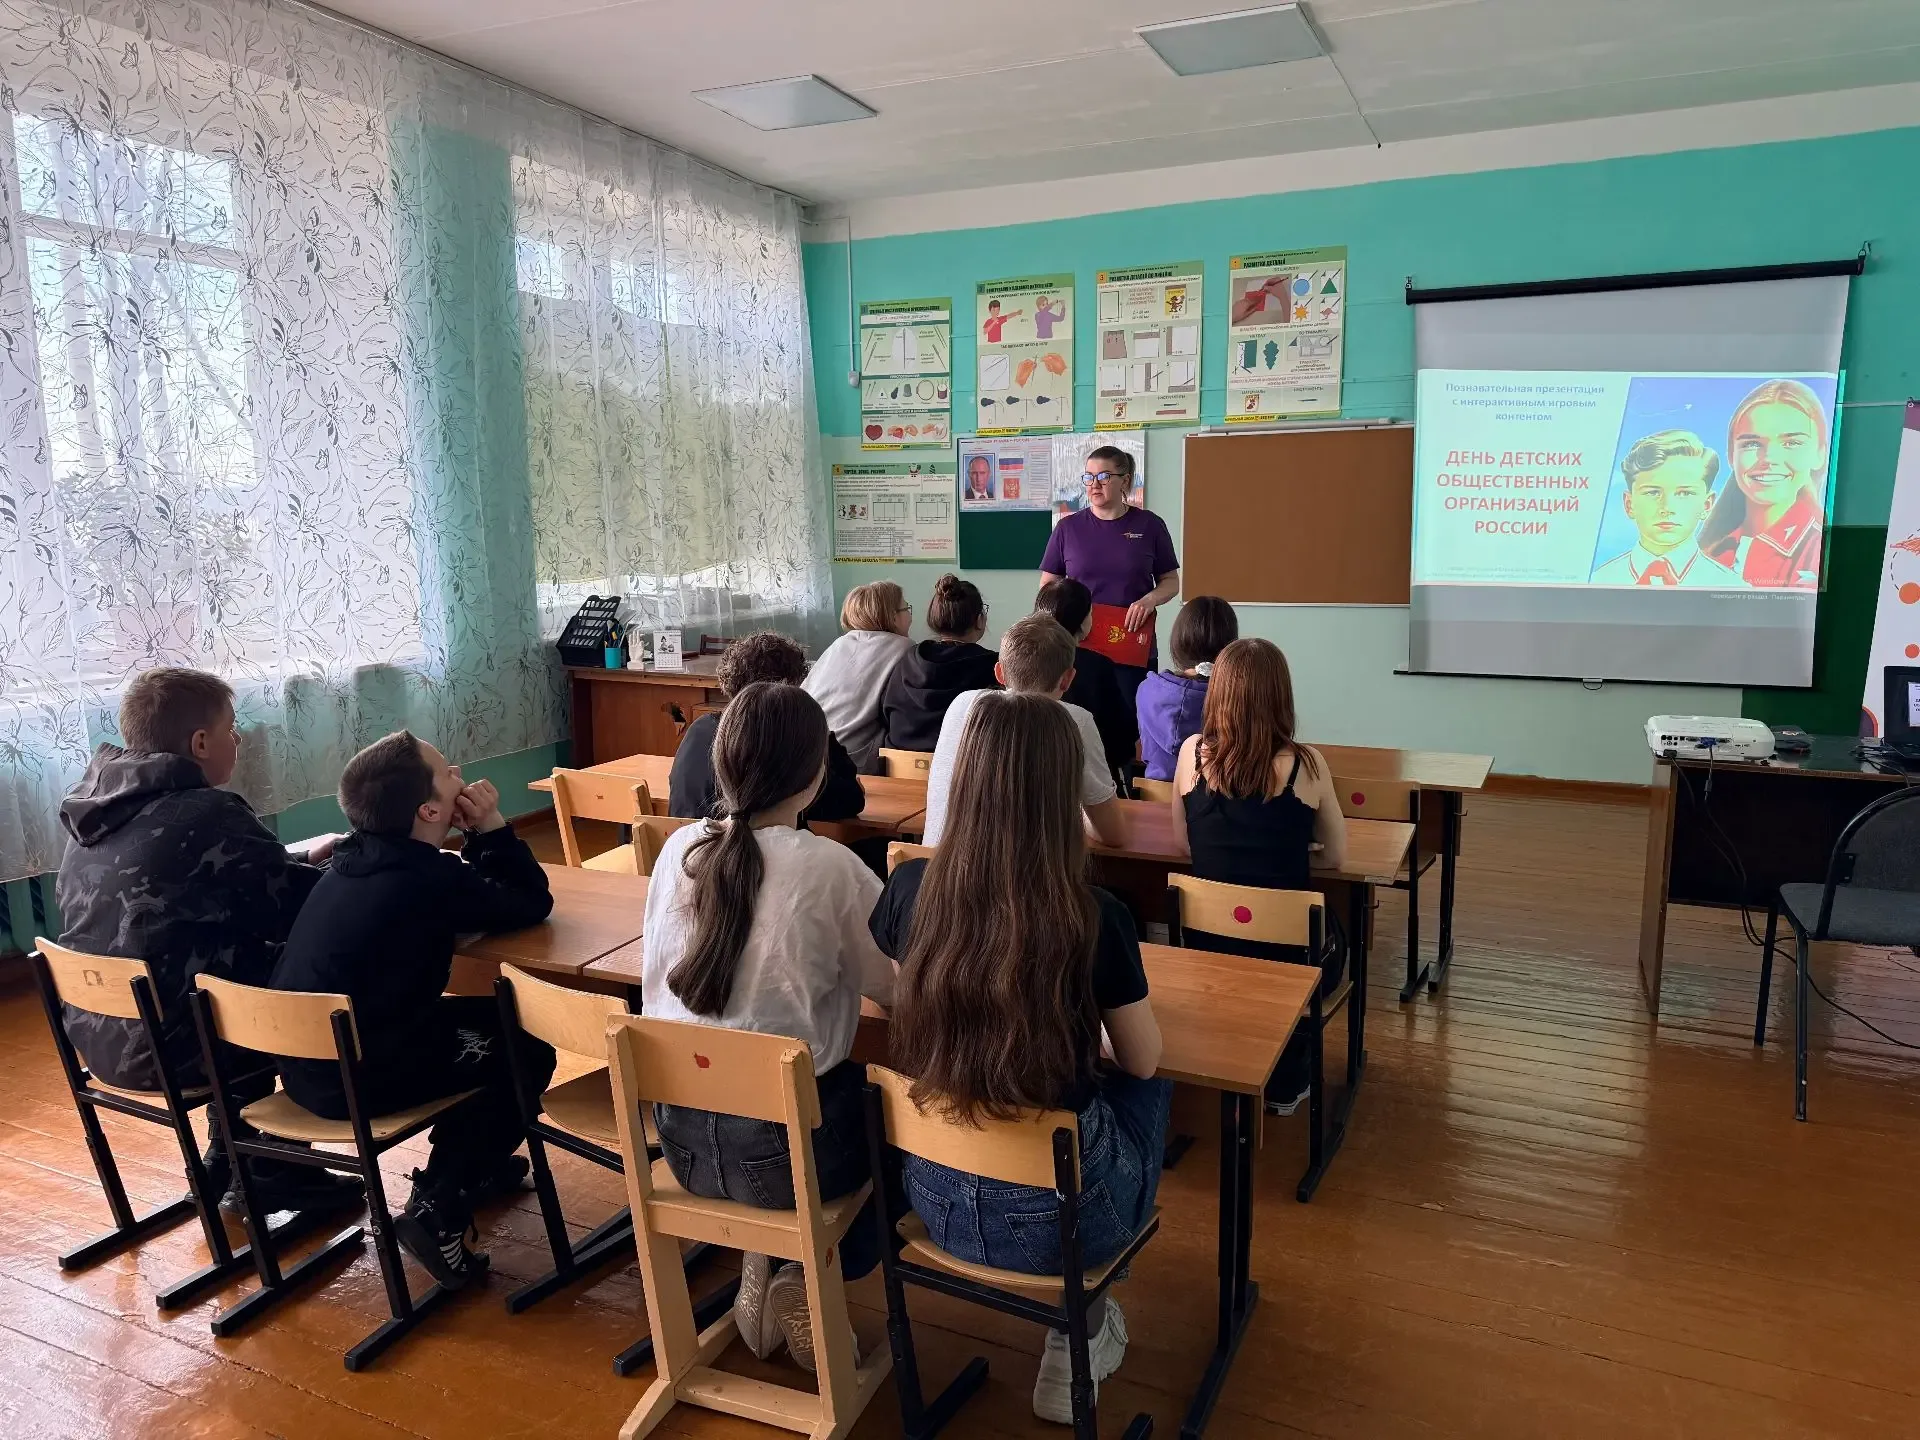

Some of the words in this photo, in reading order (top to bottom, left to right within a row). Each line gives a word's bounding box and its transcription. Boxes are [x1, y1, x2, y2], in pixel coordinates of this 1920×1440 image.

[1445, 383, 1533, 393] Познавательная
[1535, 384, 1604, 395] презентация
[1460, 399, 1546, 407] интерактивным
[1548, 400, 1596, 408] игровым
[1495, 413, 1552, 421] контентом
[1445, 451, 1496, 466] ДЕНЬ
[1499, 452, 1582, 468] ДЕТСКИХ
[1437, 473, 1589, 490] ОБЩЕСТВЕННЫХ
[1444, 496, 1579, 514] ОРГАНИЗАЦИЙ
[1474, 520, 1548, 535] РОССИИ
